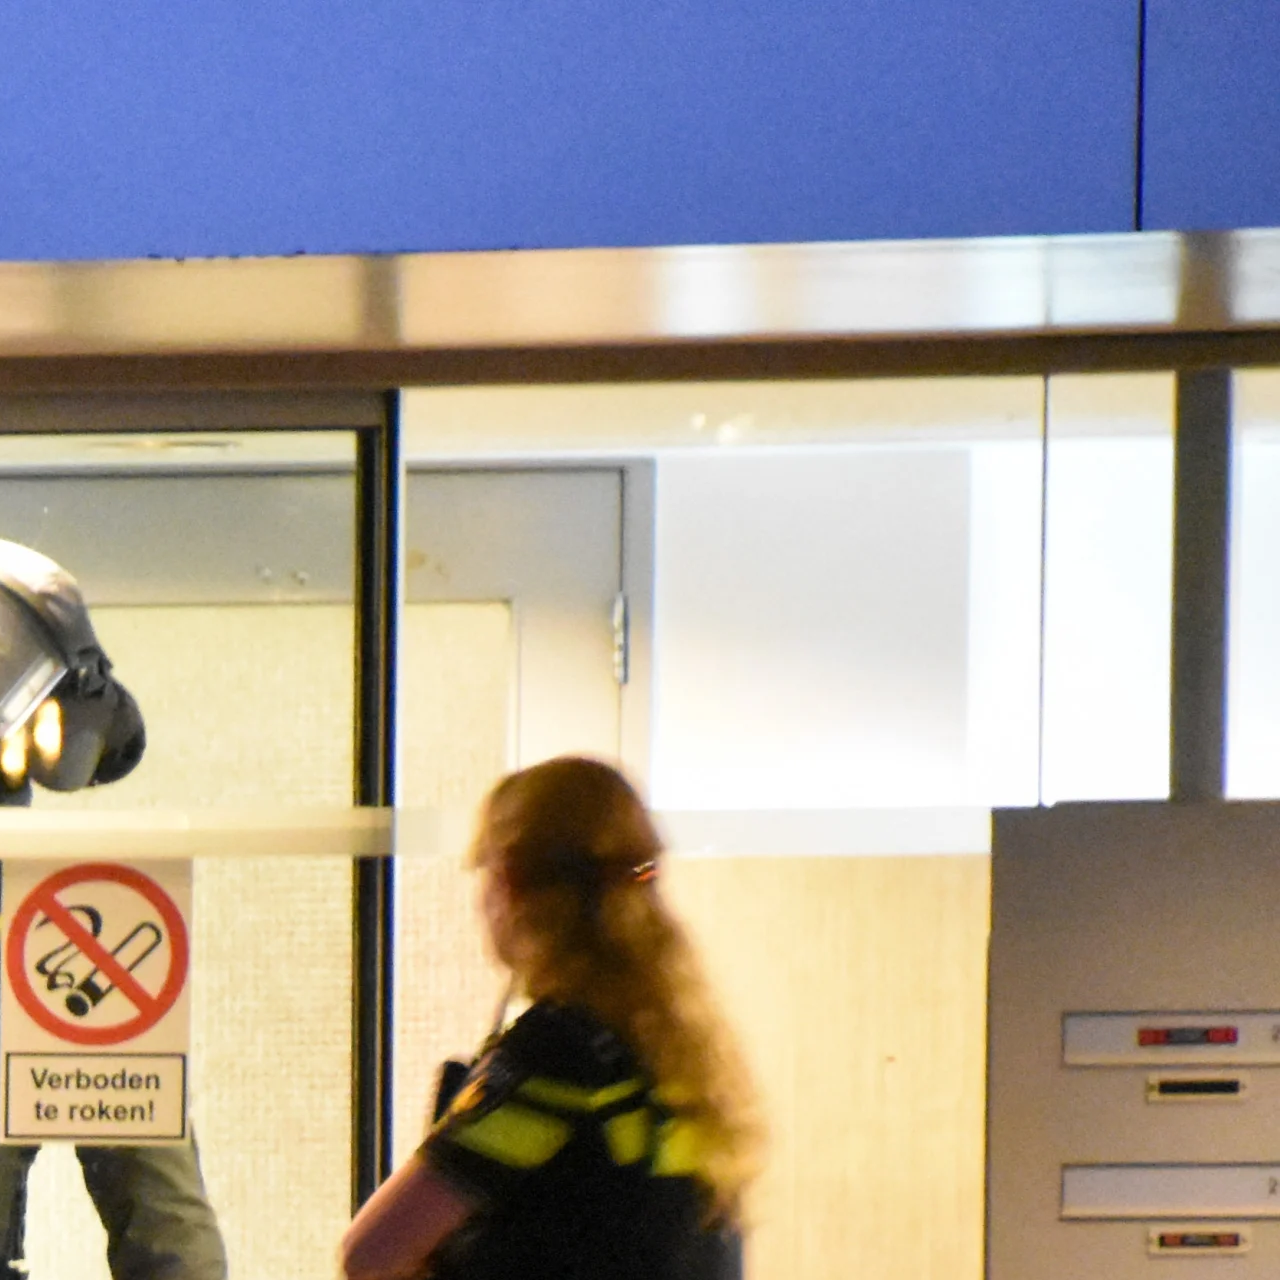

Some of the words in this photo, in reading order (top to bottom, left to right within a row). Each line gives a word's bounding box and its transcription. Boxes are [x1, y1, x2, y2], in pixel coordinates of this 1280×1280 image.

[30, 1067, 161, 1090] Verboden
[34, 1102, 59, 1121] te
[68, 1099, 155, 1122] roken!
